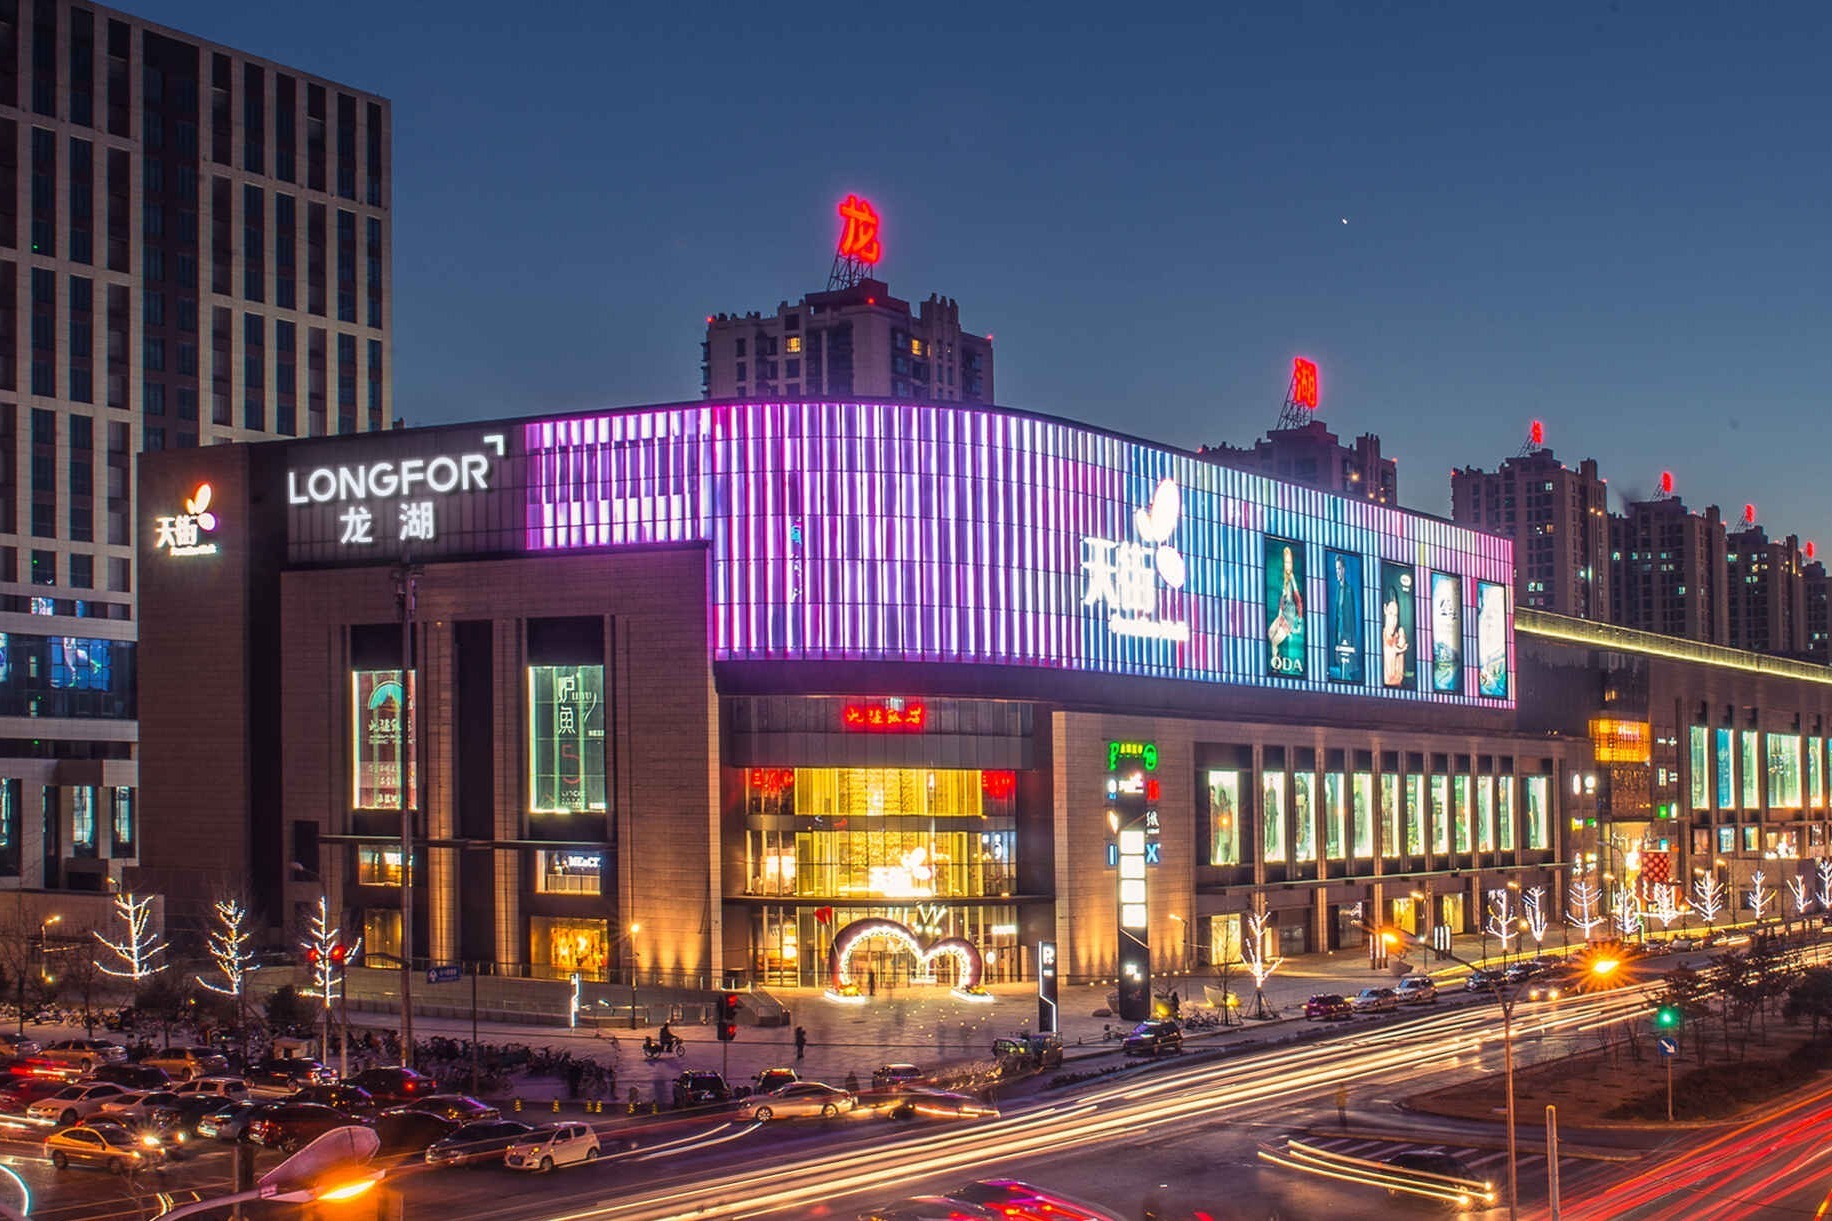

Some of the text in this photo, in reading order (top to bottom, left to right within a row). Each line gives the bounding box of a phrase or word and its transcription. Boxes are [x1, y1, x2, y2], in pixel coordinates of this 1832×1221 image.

[840, 194, 880, 263] 龙
[288, 454, 489, 504] LONGFOR
[339, 502, 434, 545] 龙湖
